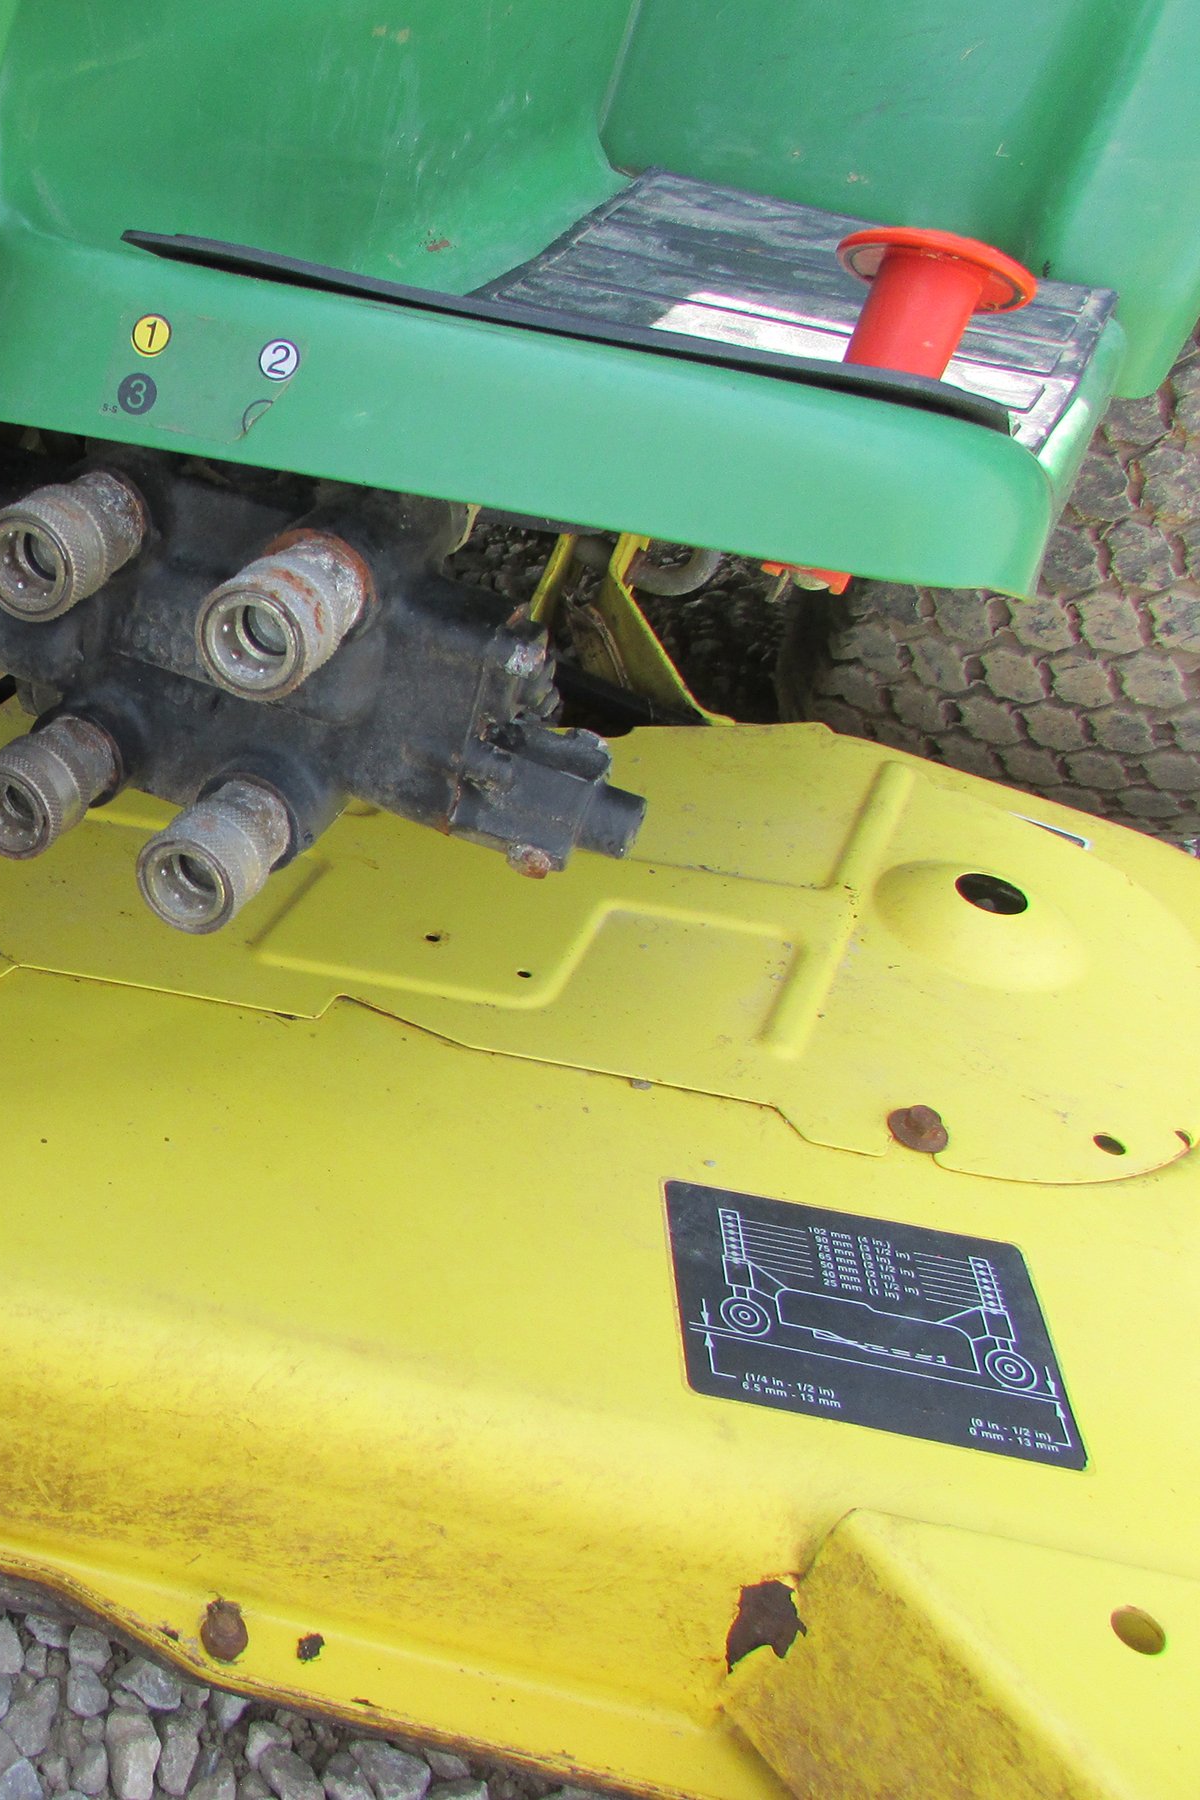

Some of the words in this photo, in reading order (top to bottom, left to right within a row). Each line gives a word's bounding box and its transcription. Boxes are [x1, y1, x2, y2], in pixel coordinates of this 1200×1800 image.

[146, 320, 157, 348] 1
[266, 345, 290, 375] 2
[126, 379, 147, 408] 3
[808, 1226, 826, 1236] 102
[830, 1231, 851, 1240] mm
[858, 1236, 868, 1244] (4
[872, 1238, 891, 1249] in.)
[815, 1235, 828, 1243] 90
[832, 1240, 853, 1248] mm
[859, 1244, 870, 1252] (3
[876, 1247, 892, 1256] 1/2
[895, 1250, 910, 1260] in)
[816, 1244, 830, 1252] 75
[834, 1248, 854, 1257] mm
[862, 1252, 872, 1260] (3
[876, 1254, 890, 1265] in)
[818, 1252, 832, 1261] 65
[836, 1256, 857, 1265] mm
[864, 1260, 874, 1269] (2
[880, 1264, 896, 1273] 1/2
[900, 1268, 915, 1278] in)
[820, 1261, 834, 1270] 50
[838, 1265, 858, 1274] mm
[866, 1270, 876, 1278] (2
[880, 1272, 895, 1282] in)
[822, 1270, 835, 1278] 40
[840, 1274, 860, 1282] mm
[867, 1279, 877, 1287] (1
[884, 1282, 900, 1291] 1/2
[904, 1286, 920, 1296] in)
[824, 1278, 837, 1287] 25
[841, 1283, 862, 1292] mm
[870, 1288, 879, 1296] (1
[884, 1290, 900, 1300] in)
[742, 1381, 761, 1392] 6.5
[765, 1387, 787, 1397] mm
[800, 1393, 814, 1402] 13
[818, 1397, 841, 1408] mm
[745, 1372, 768, 1384] (1/4
[772, 1377, 784, 1387] in
[797, 1382, 814, 1393] 1/2
[818, 1386, 834, 1399] in)
[969, 1426, 977, 1435] 0
[981, 1431, 1004, 1441] mm
[1017, 1437, 1031, 1447] 13
[1035, 1442, 1060, 1452] mm
[971, 1417, 983, 1427] (0
[987, 1421, 1000, 1430] in
[1012, 1426, 1030, 1437] 1/2
[1035, 1431, 1051, 1443] in)
